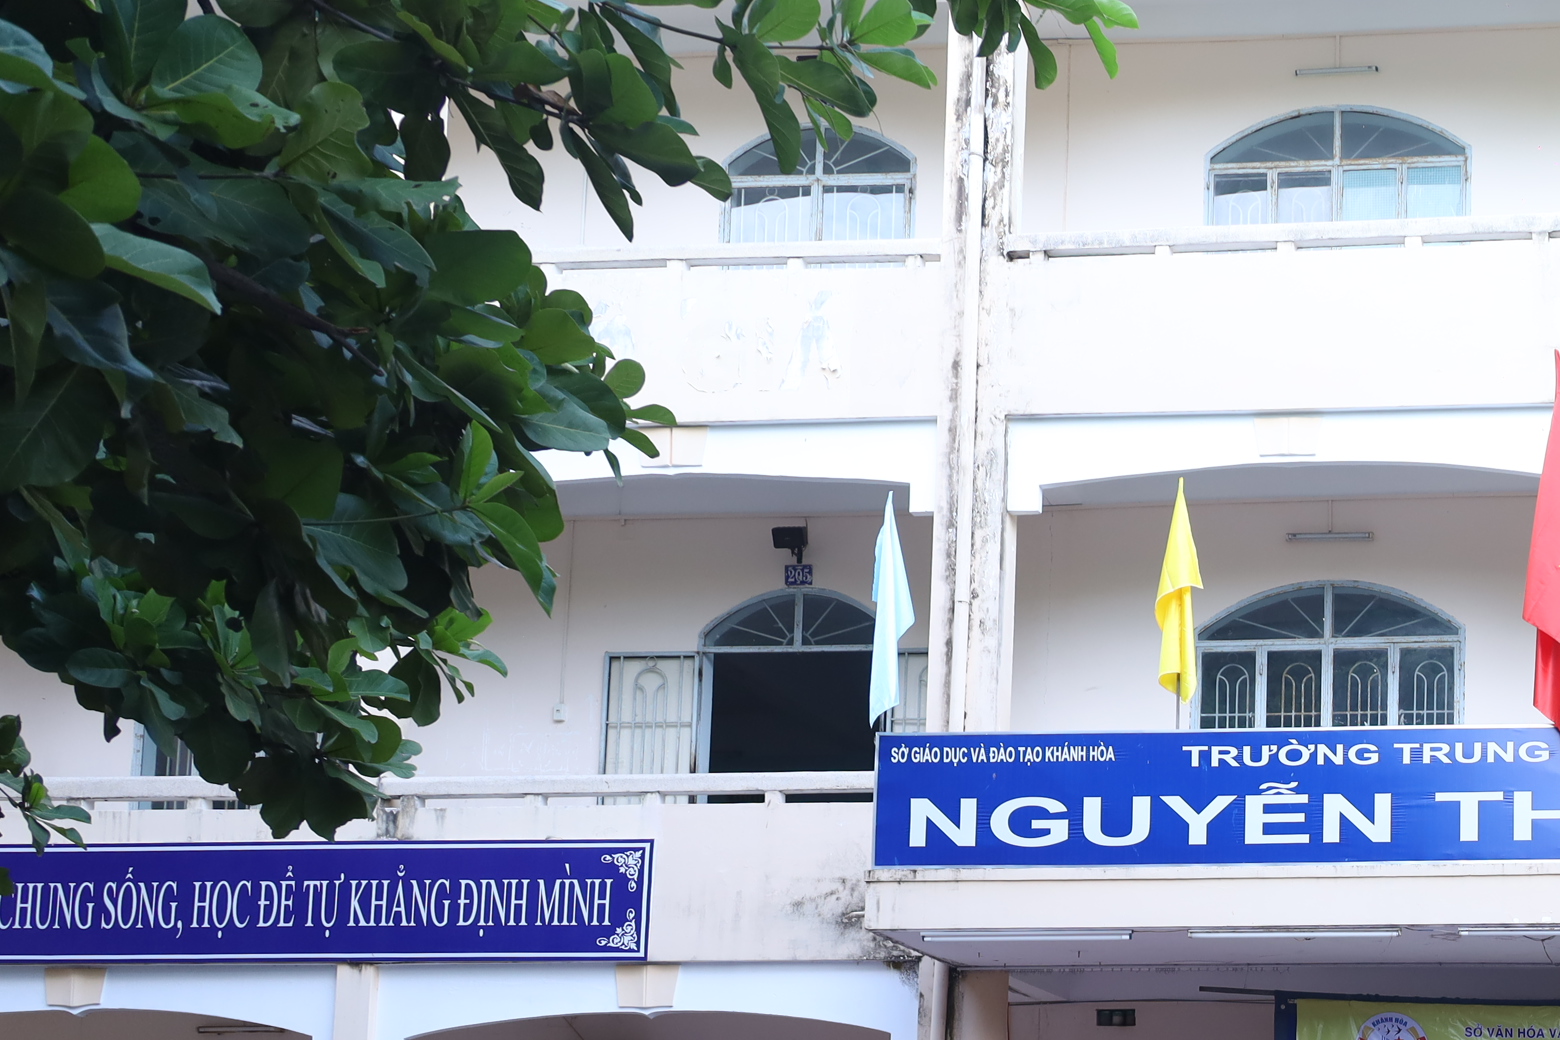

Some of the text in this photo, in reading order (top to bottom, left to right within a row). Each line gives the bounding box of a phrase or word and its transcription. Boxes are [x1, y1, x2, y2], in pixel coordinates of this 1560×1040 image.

[788, 567, 811, 583] 205
[891, 740, 1115, 766] SỞ GIÁO DỤC VÀ ĐÀO TẠO KHÁNH HÒA
[1182, 739, 1380, 767] TRƯỜNG
[1394, 741, 1550, 764] TRUNG
[908, 781, 1393, 848] NGUYỄN
[101, 867, 183, 939] SỐNG,
[190, 880, 251, 938] HỌC
[256, 865, 296, 928] ĐỂ
[303, 873, 344, 938] TỰ
[347, 864, 451, 927] KHẲNG
[456, 879, 530, 937] ĐỊNH
[535, 863, 613, 926] MÌNH
[1464, 1023, 1482, 1038] SỞ
[1488, 1024, 1513, 1038] VĂN
[1518, 1024, 1544, 1038] HÓA
